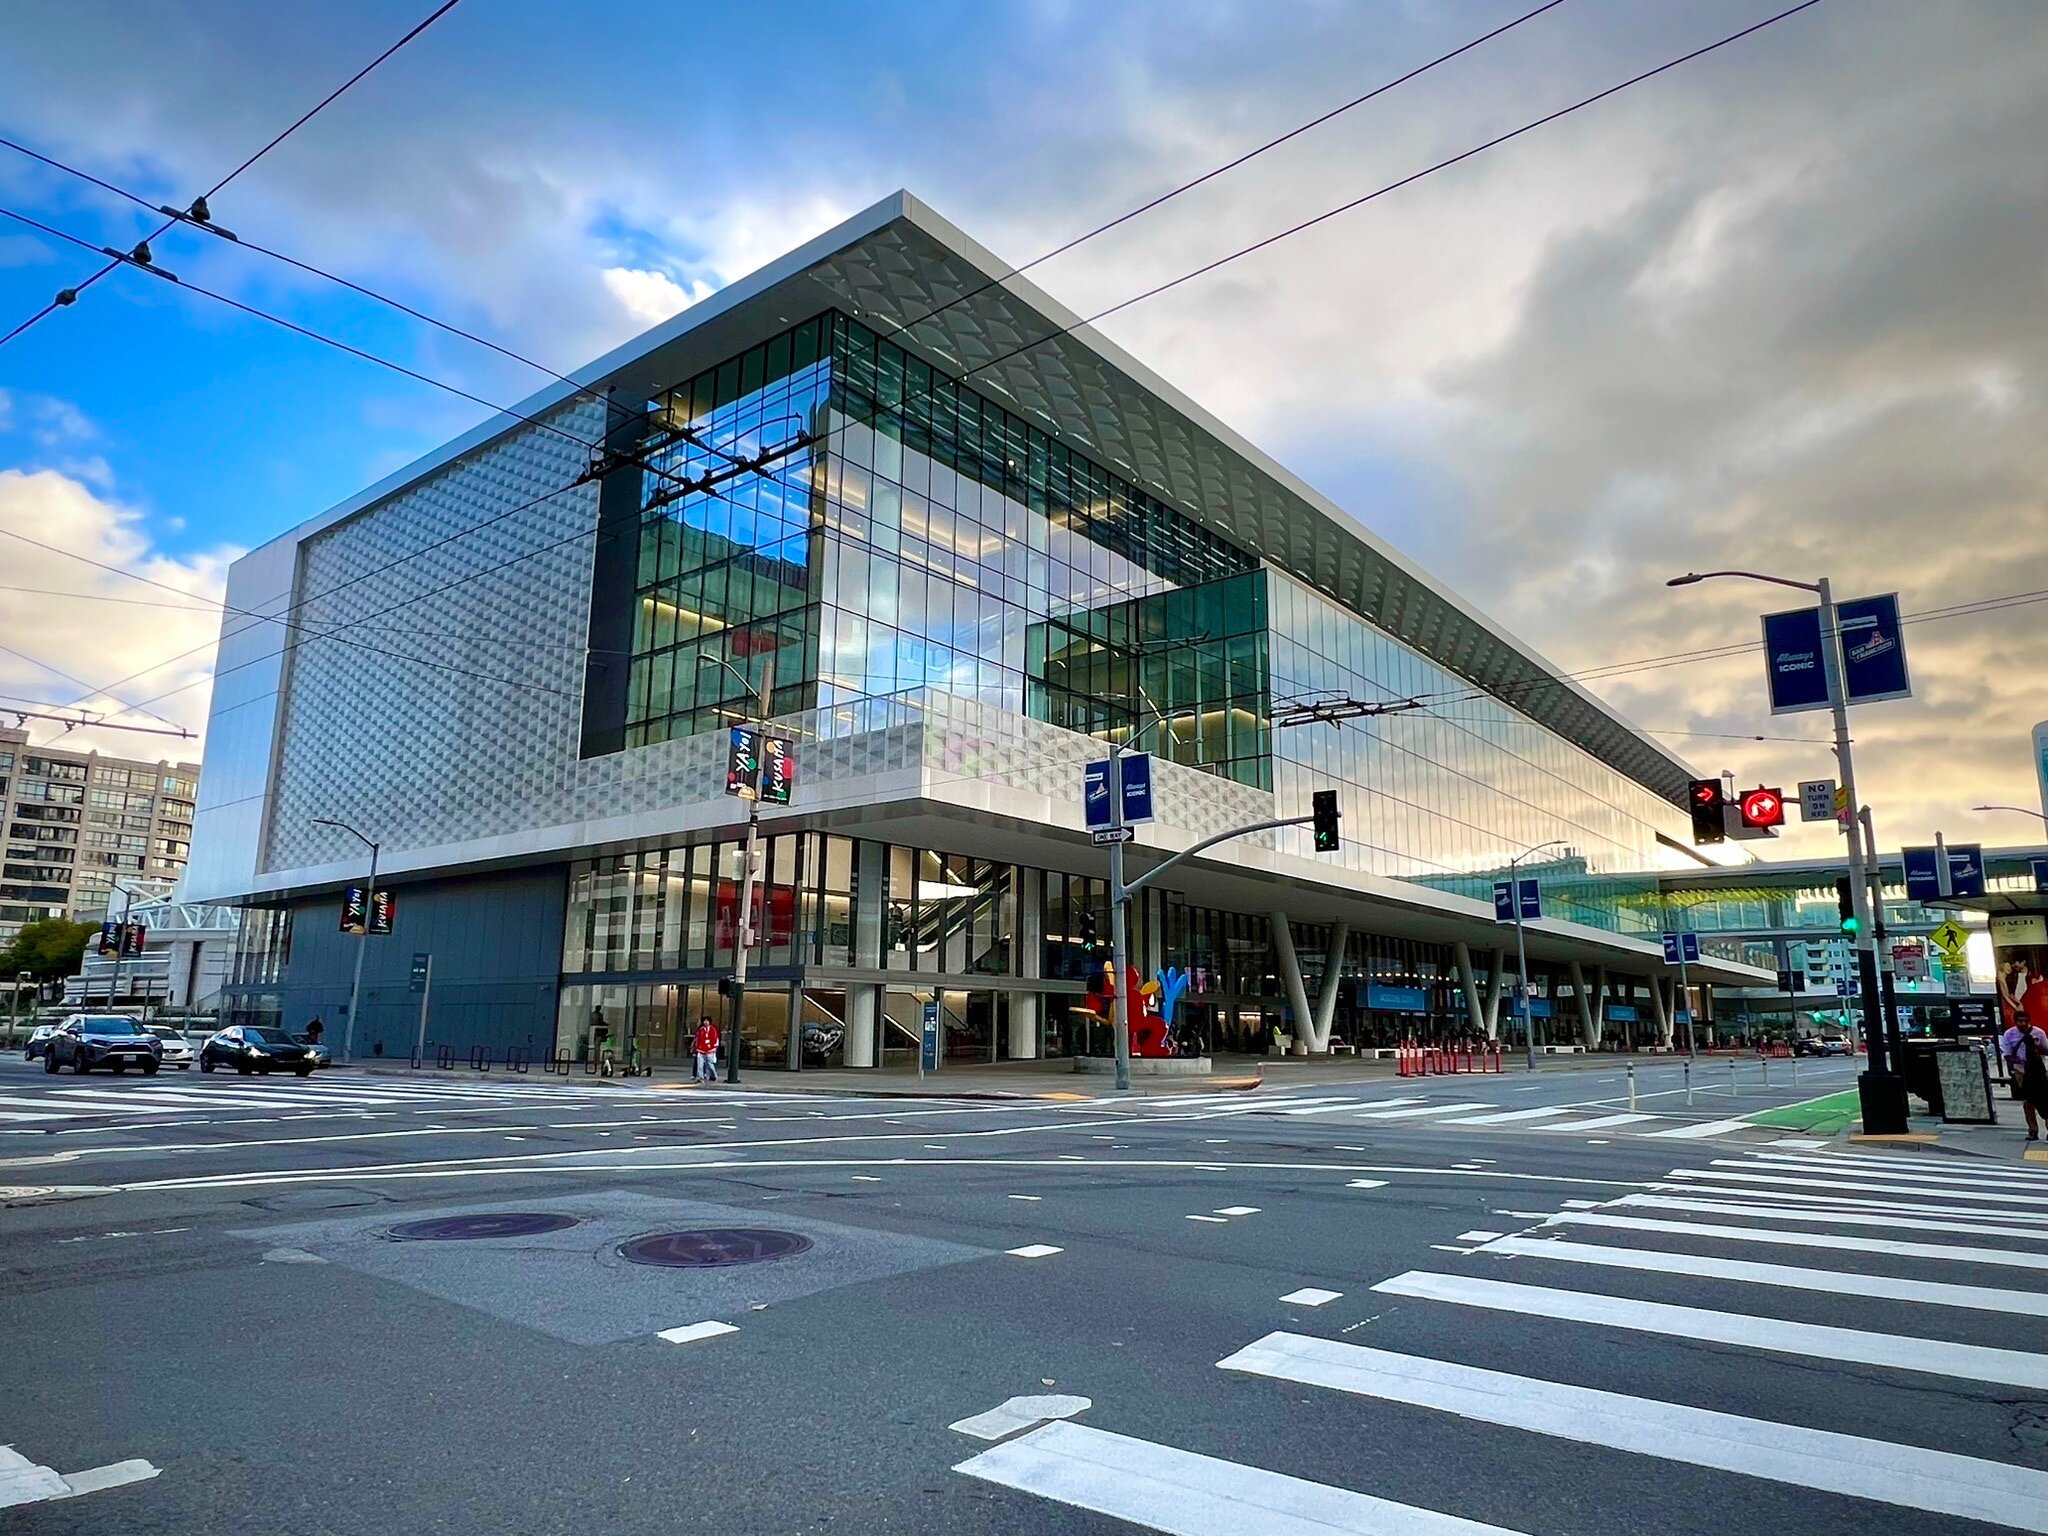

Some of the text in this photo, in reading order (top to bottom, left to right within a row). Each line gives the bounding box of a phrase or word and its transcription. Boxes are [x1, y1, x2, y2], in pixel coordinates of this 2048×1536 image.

[1776, 651, 1814, 663] Always
[1779, 661, 1815, 673] ICONIC
[772, 739, 785, 792] KUSAMA
[1808, 784, 1826, 792] NO
[1097, 833, 1108, 841] ONE
[377, 891, 389, 927] KUSAMA
[1993, 919, 2034, 927] COACH
